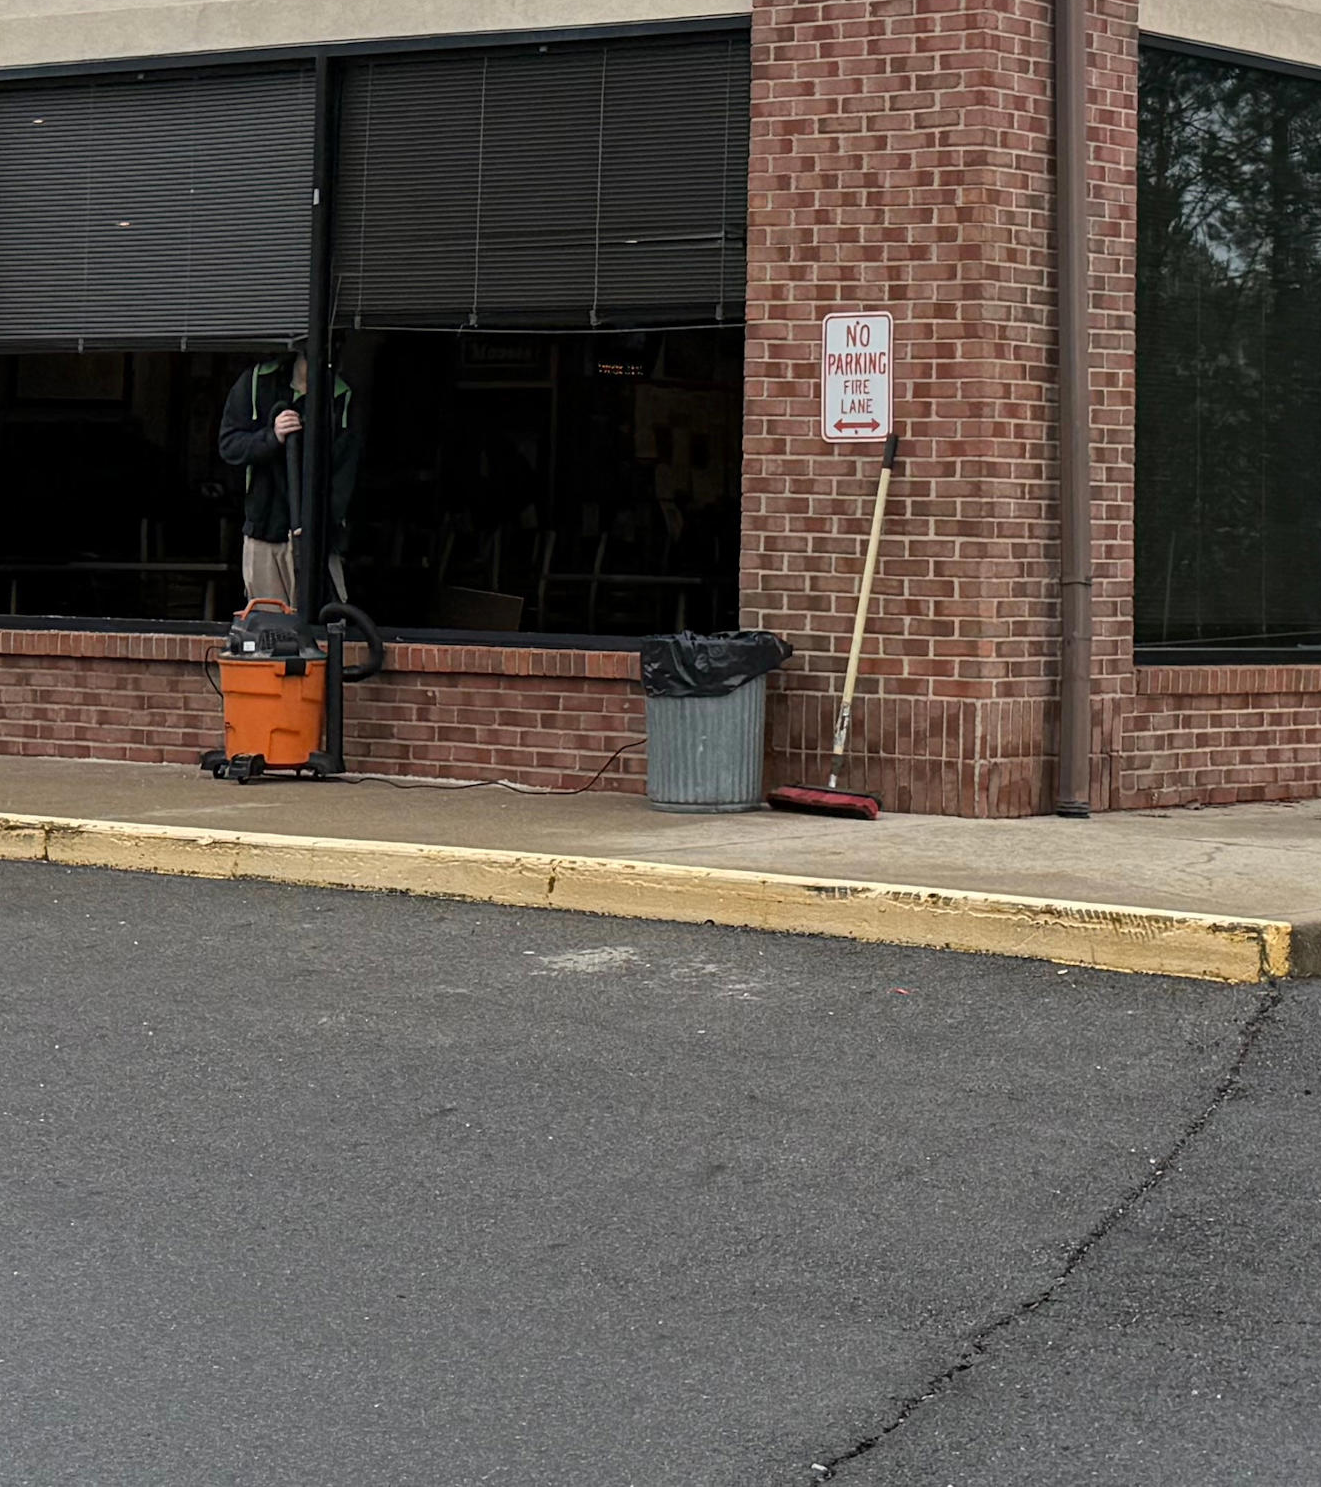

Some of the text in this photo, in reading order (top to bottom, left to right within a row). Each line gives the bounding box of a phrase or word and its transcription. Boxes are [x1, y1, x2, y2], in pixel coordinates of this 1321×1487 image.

[846, 324, 870, 347] NO
[828, 352, 886, 375] PARKING
[843, 379, 870, 395] FIRE
[841, 398, 873, 414] LANE
